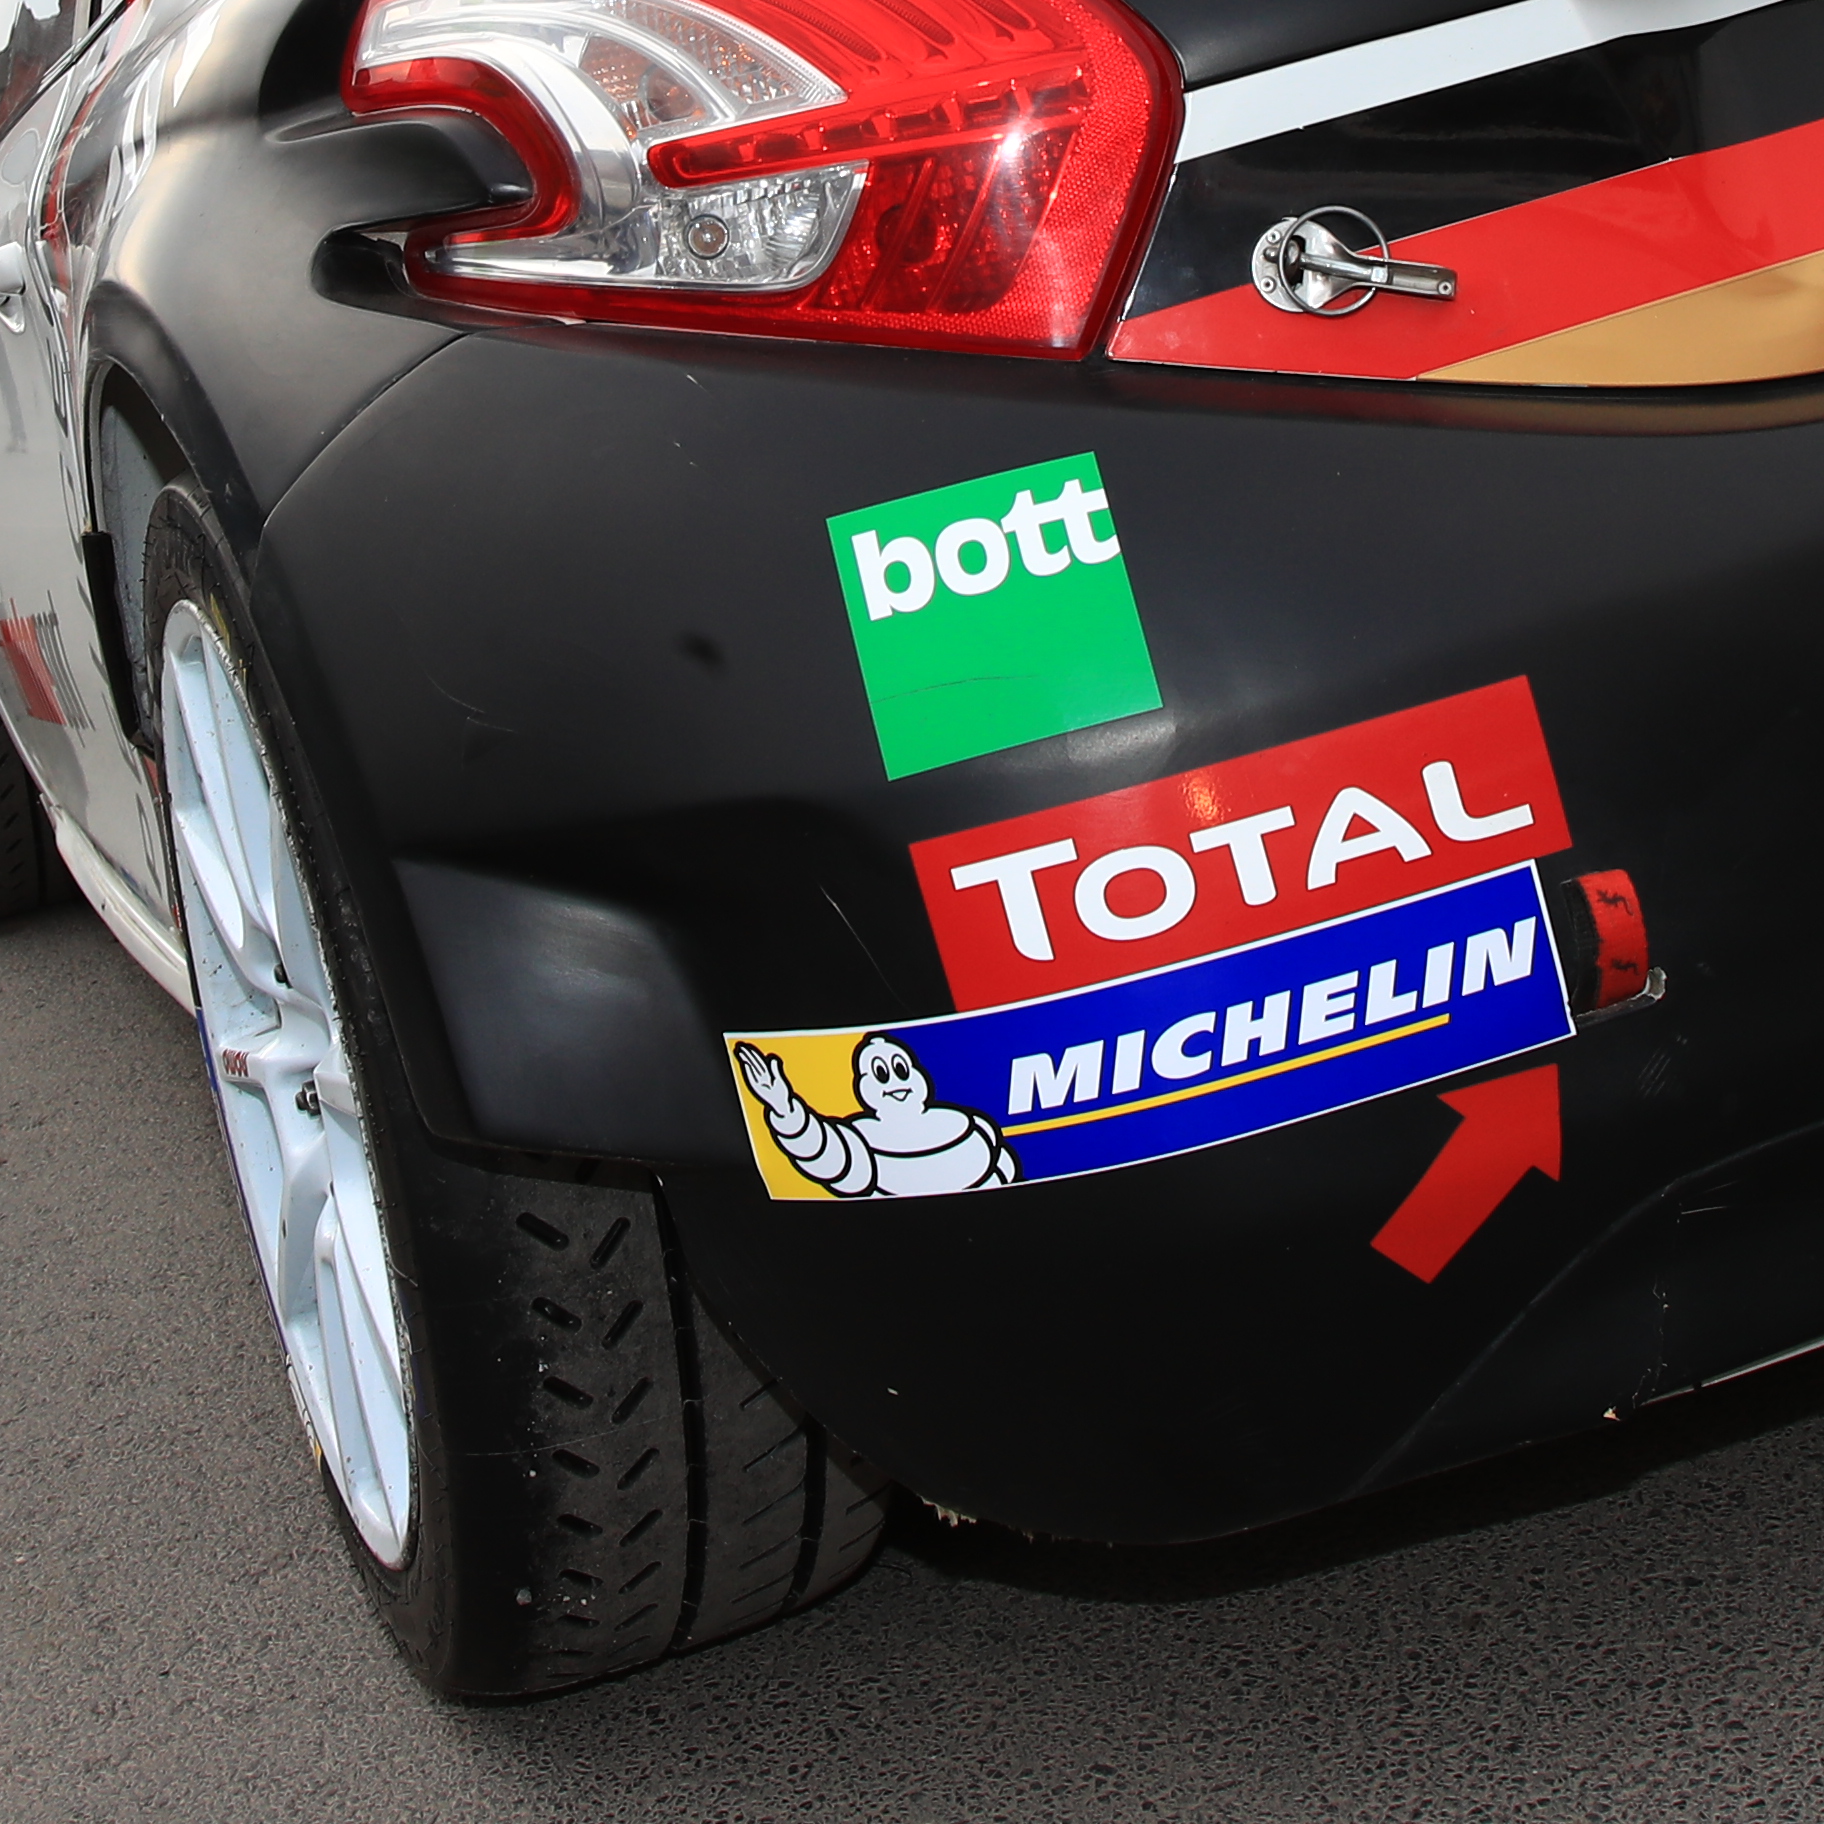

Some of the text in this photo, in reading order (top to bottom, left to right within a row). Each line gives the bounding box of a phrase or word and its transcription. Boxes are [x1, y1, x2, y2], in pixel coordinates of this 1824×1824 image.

[851, 477, 1120, 621] bott
[949, 760, 1534, 962] TOTAL
[1007, 916, 1537, 1115] MICHELIN
